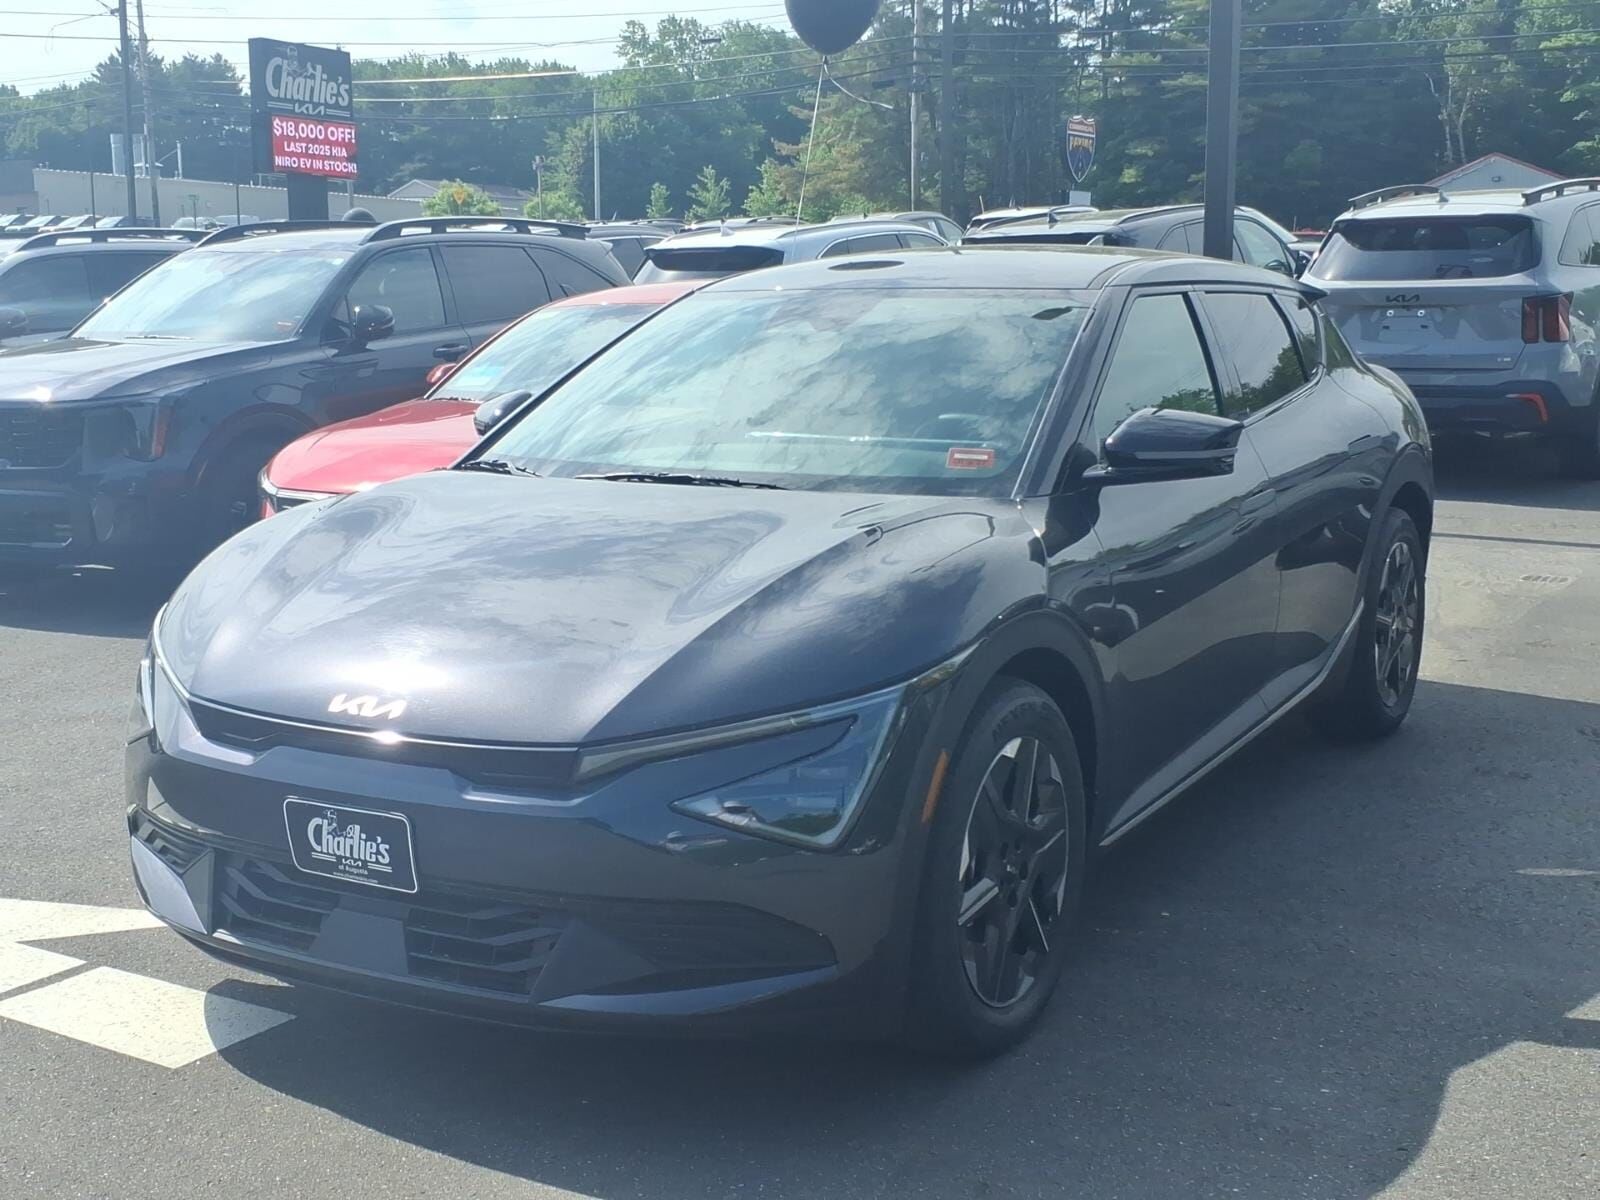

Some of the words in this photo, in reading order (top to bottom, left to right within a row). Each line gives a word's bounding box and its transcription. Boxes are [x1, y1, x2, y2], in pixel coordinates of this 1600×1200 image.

[265, 57, 349, 106] Charlie's
[295, 103, 325, 116] KIA
[273, 117, 325, 139] $18,000
[327, 126, 355, 143] OFF!
[284, 141, 307, 153] LAST
[308, 143, 331, 156] 2025
[332, 146, 348, 157] KIA
[275, 155, 298, 168] NIRO
[300, 158, 312, 169] EV
[313, 159, 323, 169] IN
[324, 161, 357, 173] STOCK!
[1385, 294, 1420, 303] KIA
[327, 693, 407, 720] KIA
[307, 817, 390, 864] Charlie's
[342, 858, 362, 867] KIA
